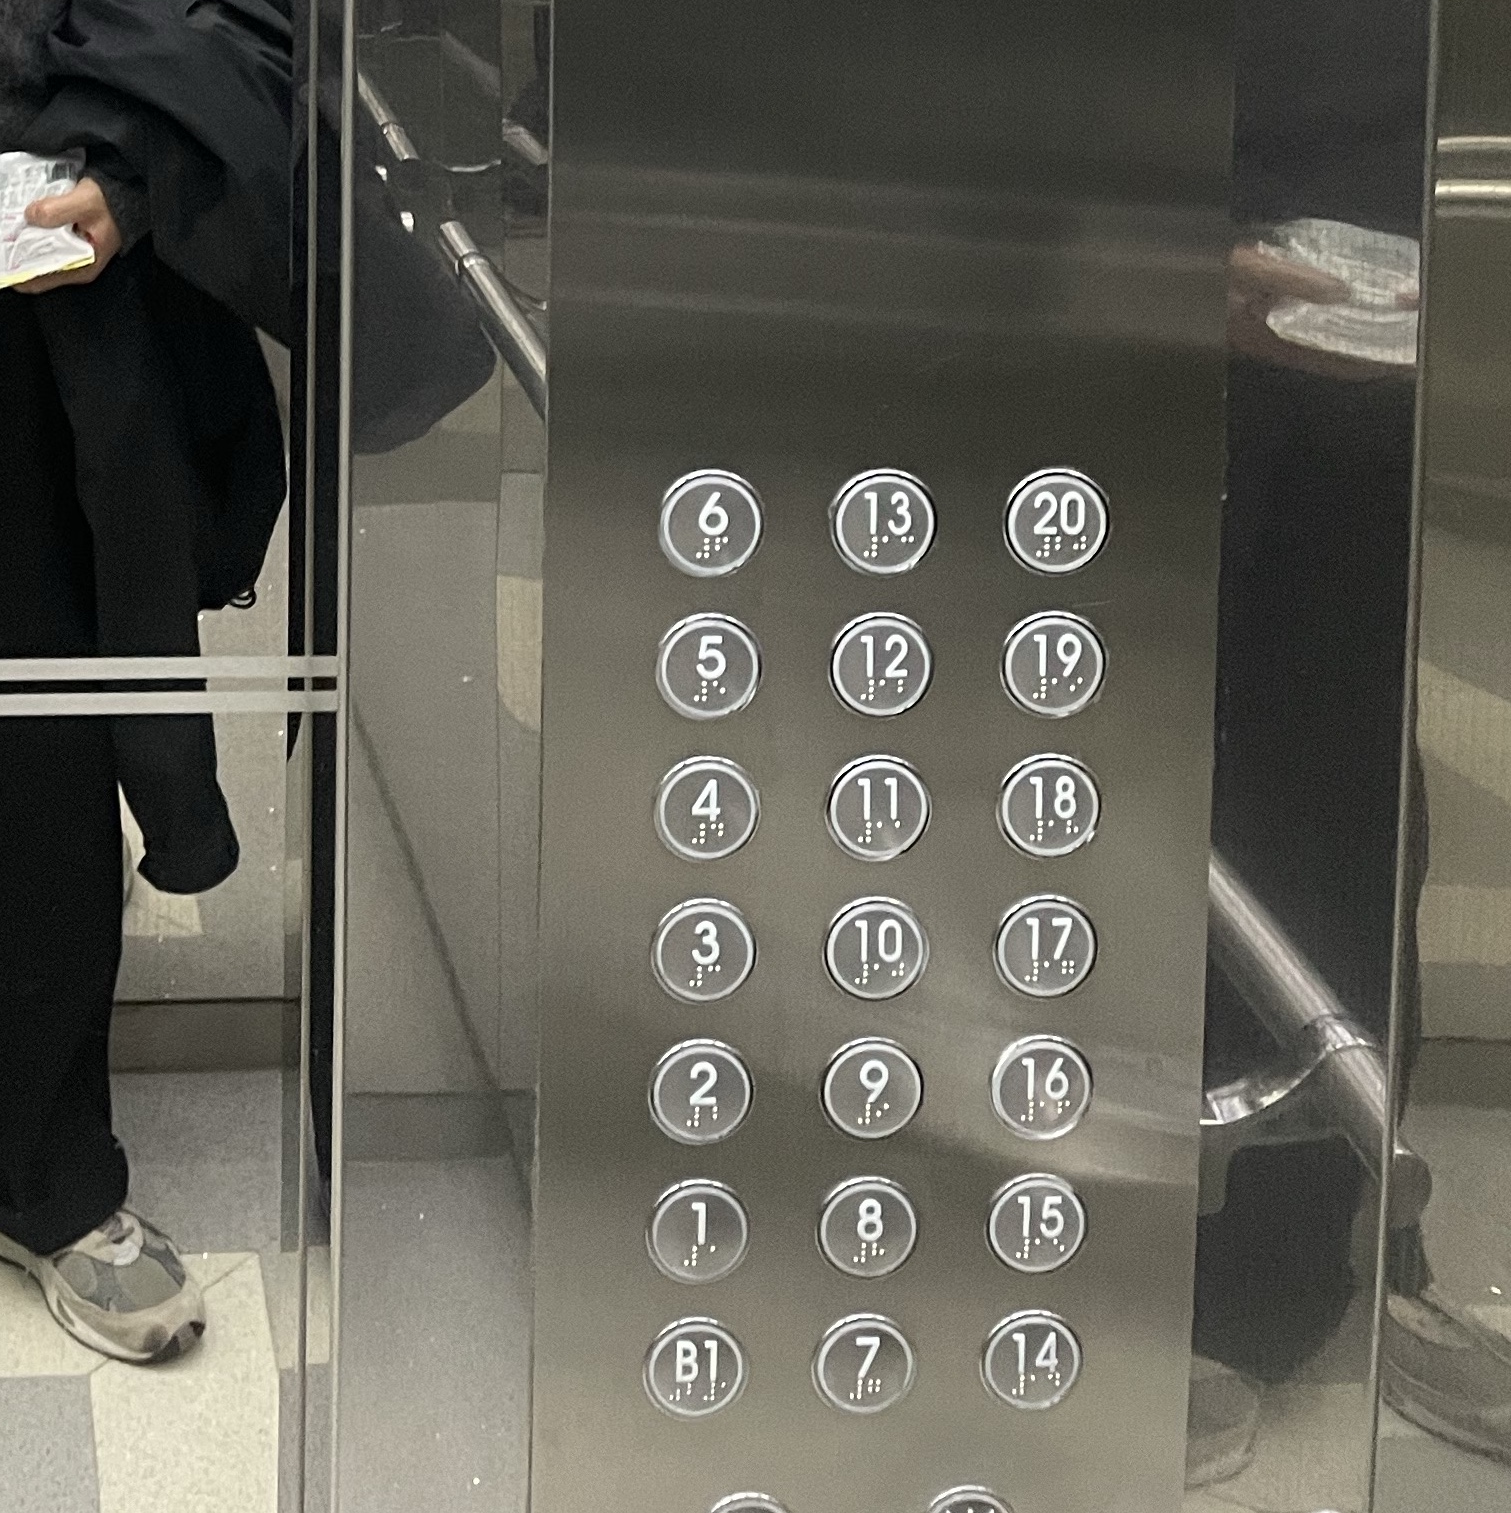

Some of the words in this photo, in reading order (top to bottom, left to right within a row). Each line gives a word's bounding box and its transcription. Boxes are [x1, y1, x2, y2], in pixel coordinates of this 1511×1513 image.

[698, 492, 728, 535] 6
[864, 492, 912, 535] 13
[1033, 491, 1086, 535] 20
[696, 635, 726, 680] 5
[861, 635, 908, 678] 12
[1033, 634, 1082, 677] 19
[691, 779, 720, 822] 4
[857, 777, 899, 820] 11
[1030, 776, 1077, 819] 18
[691, 920, 719, 965] 3
[854, 919, 903, 962] 10
[1025, 918, 1073, 961] 17
[689, 1061, 718, 1106] 2
[859, 1060, 889, 1104] 9
[1021, 1057, 1069, 1101] 16
[691, 1202, 707, 1245] 1
[856, 1198, 884, 1242] 8
[1017, 1196, 1064, 1238] 15
[675, 1340, 719, 1382] B1
[856, 1337, 880, 1378] 7
[1013, 1332, 1059, 1374] 14
